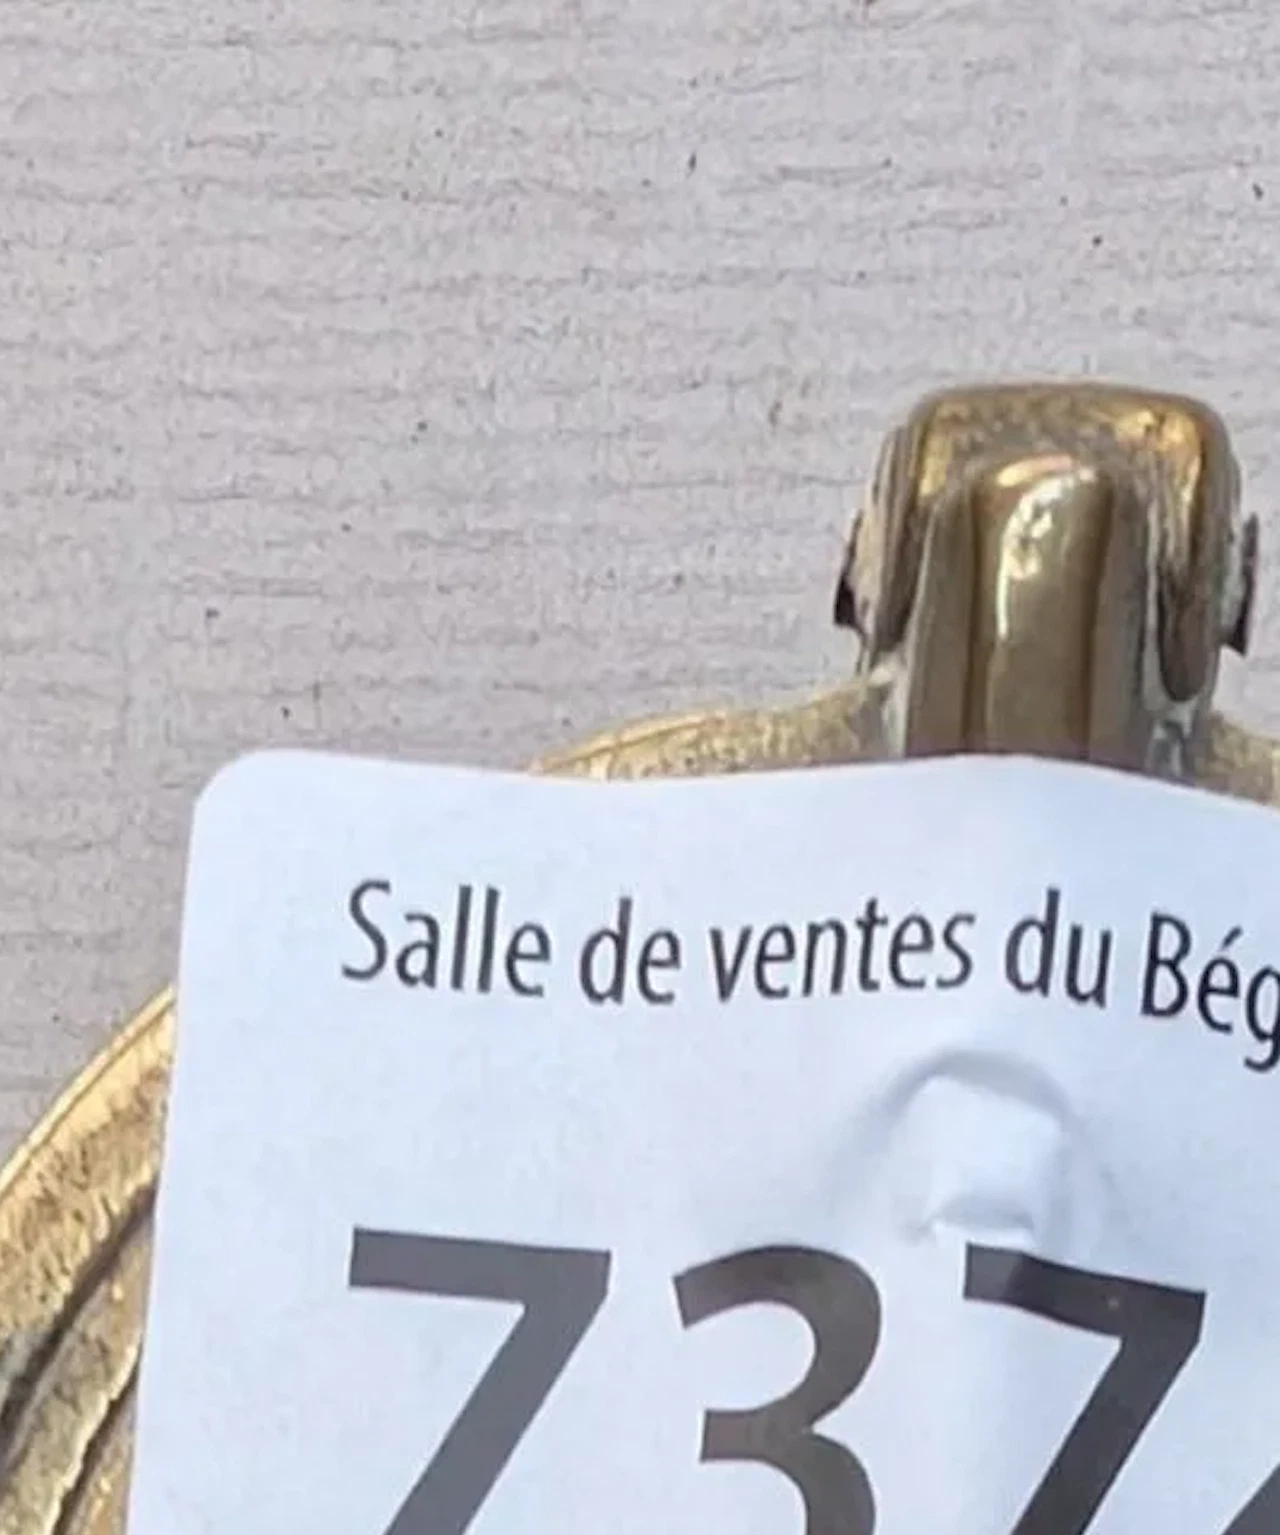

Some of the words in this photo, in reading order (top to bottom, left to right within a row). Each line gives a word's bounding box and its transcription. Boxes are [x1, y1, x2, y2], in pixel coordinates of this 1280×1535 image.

[340, 878, 551, 998] Salle
[578, 896, 681, 1004] de
[710, 896, 974, 1002] ventes
[1003, 887, 1111, 1008] du
